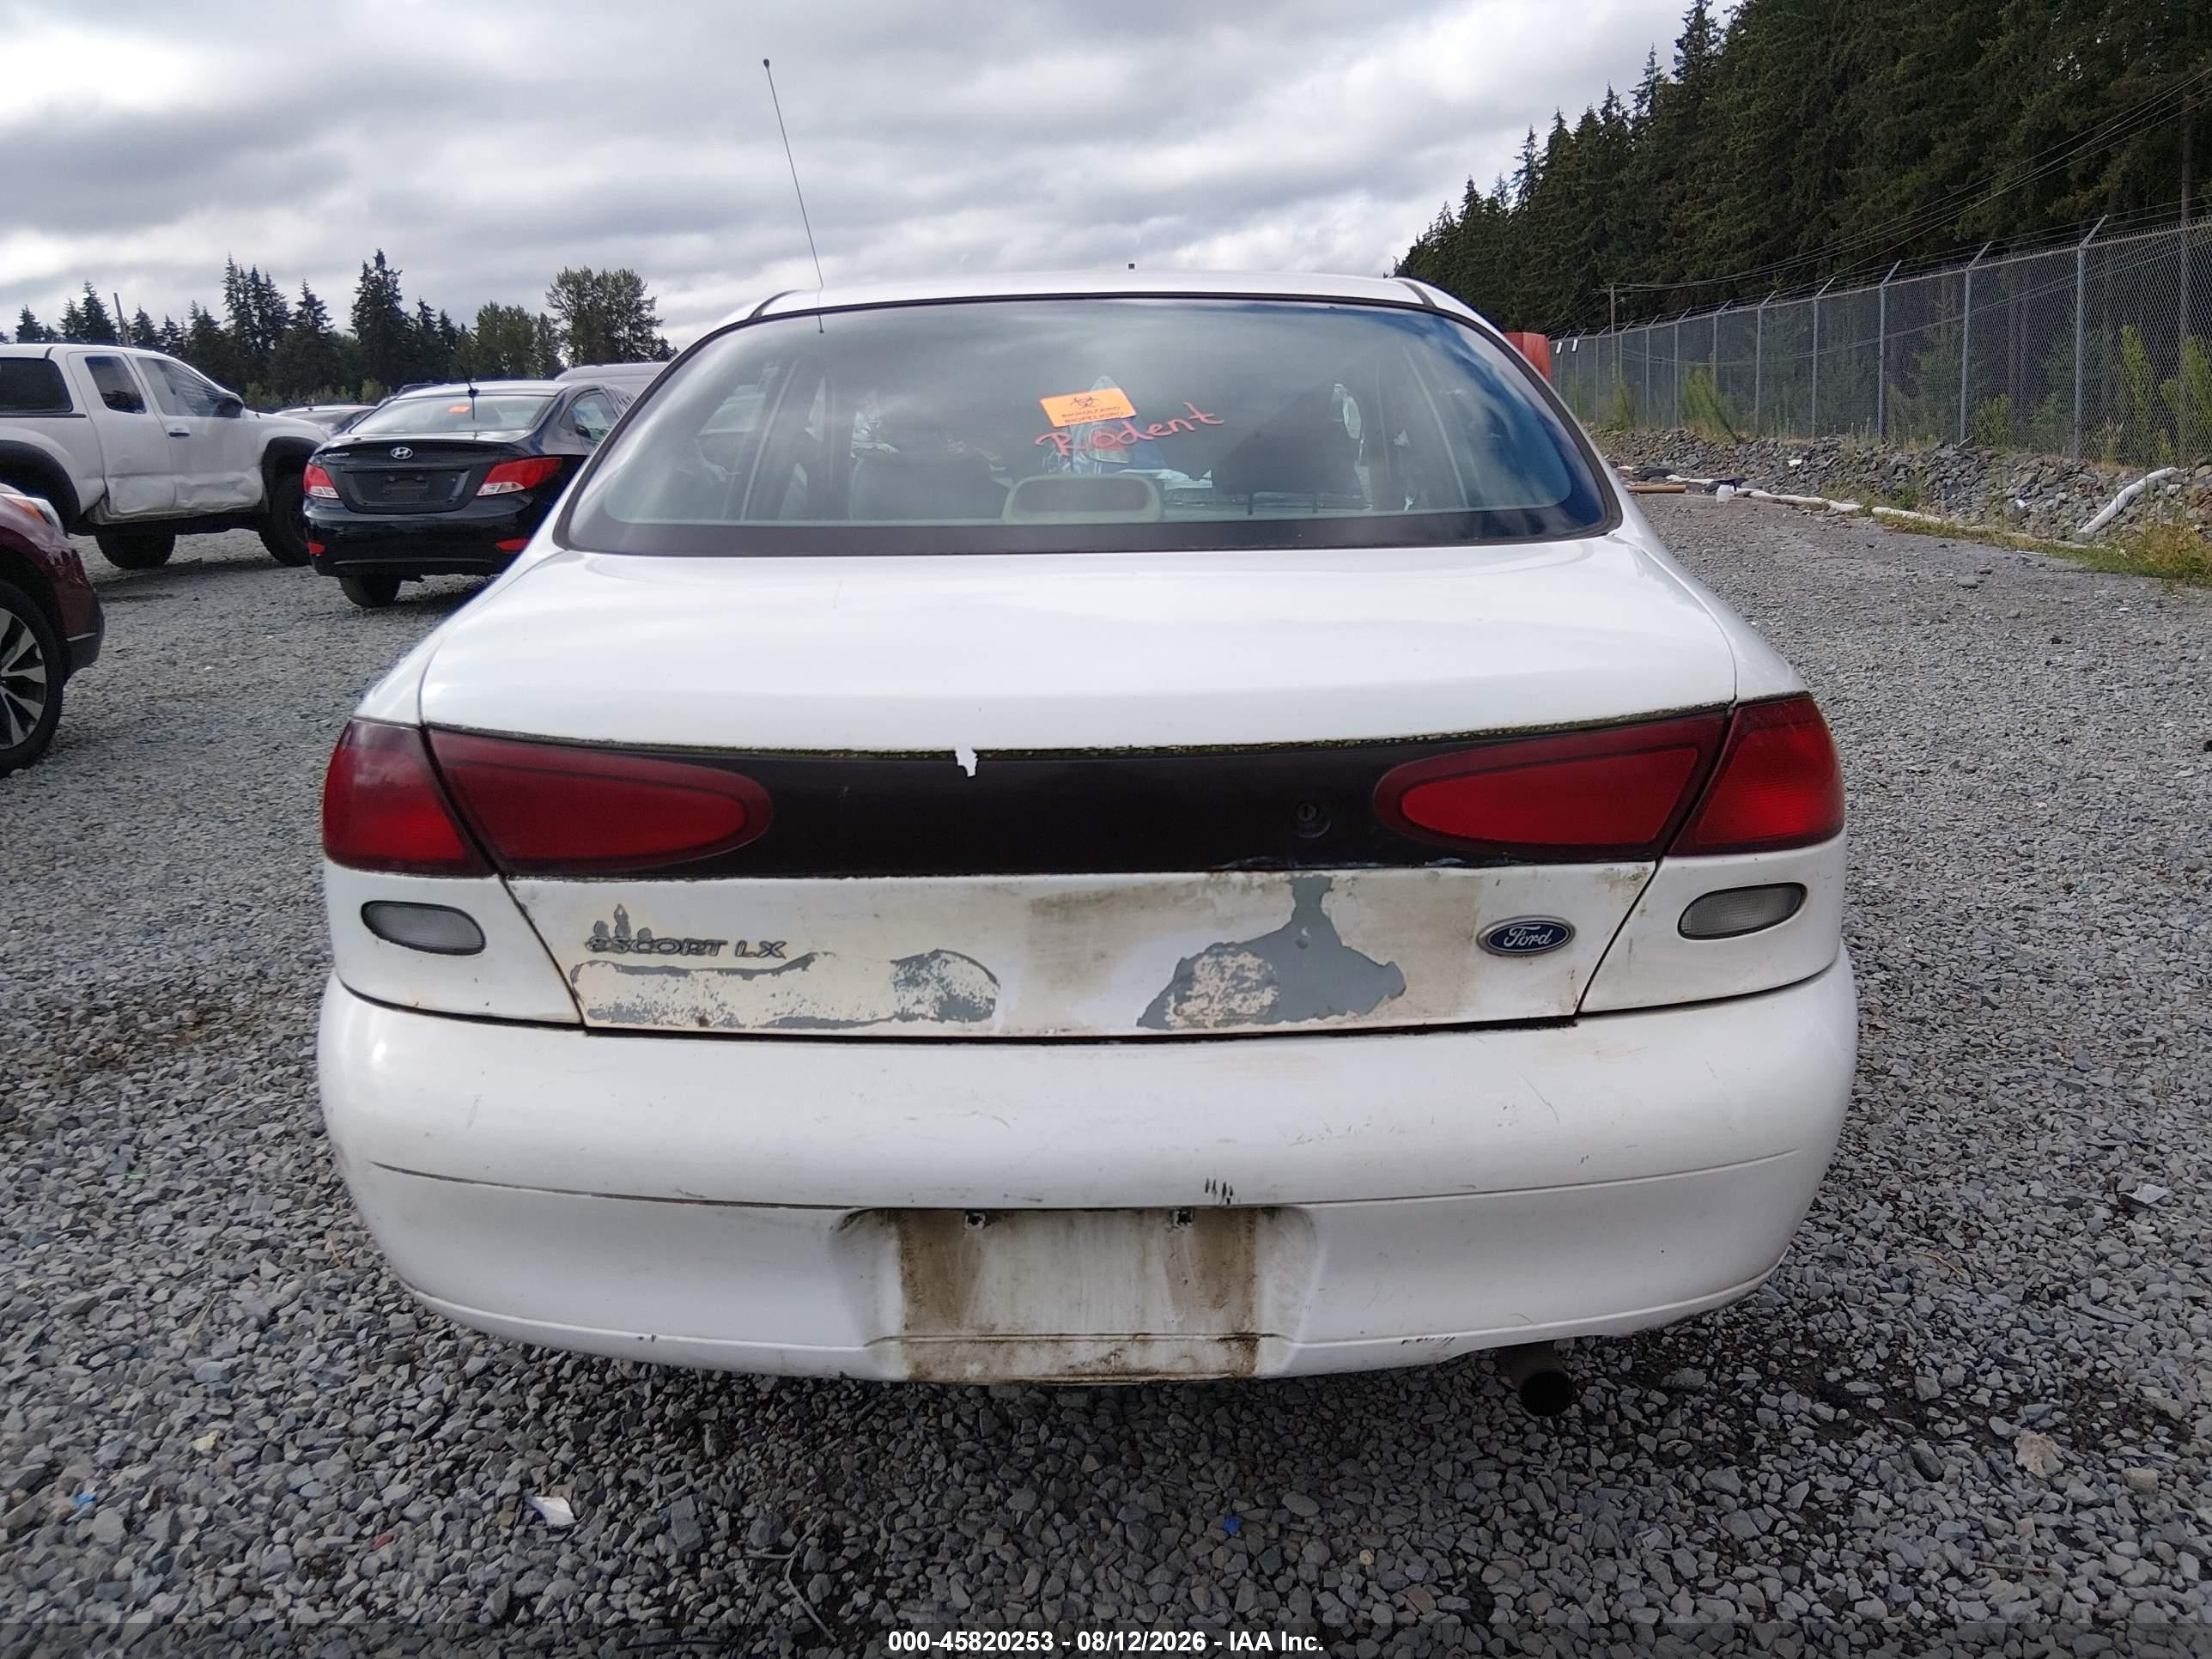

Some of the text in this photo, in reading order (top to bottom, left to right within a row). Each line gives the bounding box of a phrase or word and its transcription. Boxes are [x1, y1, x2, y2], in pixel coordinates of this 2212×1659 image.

[1034, 400, 1225, 457] Rodent
[1504, 925, 1553, 947] Ford
[734, 939, 787, 959] LX
